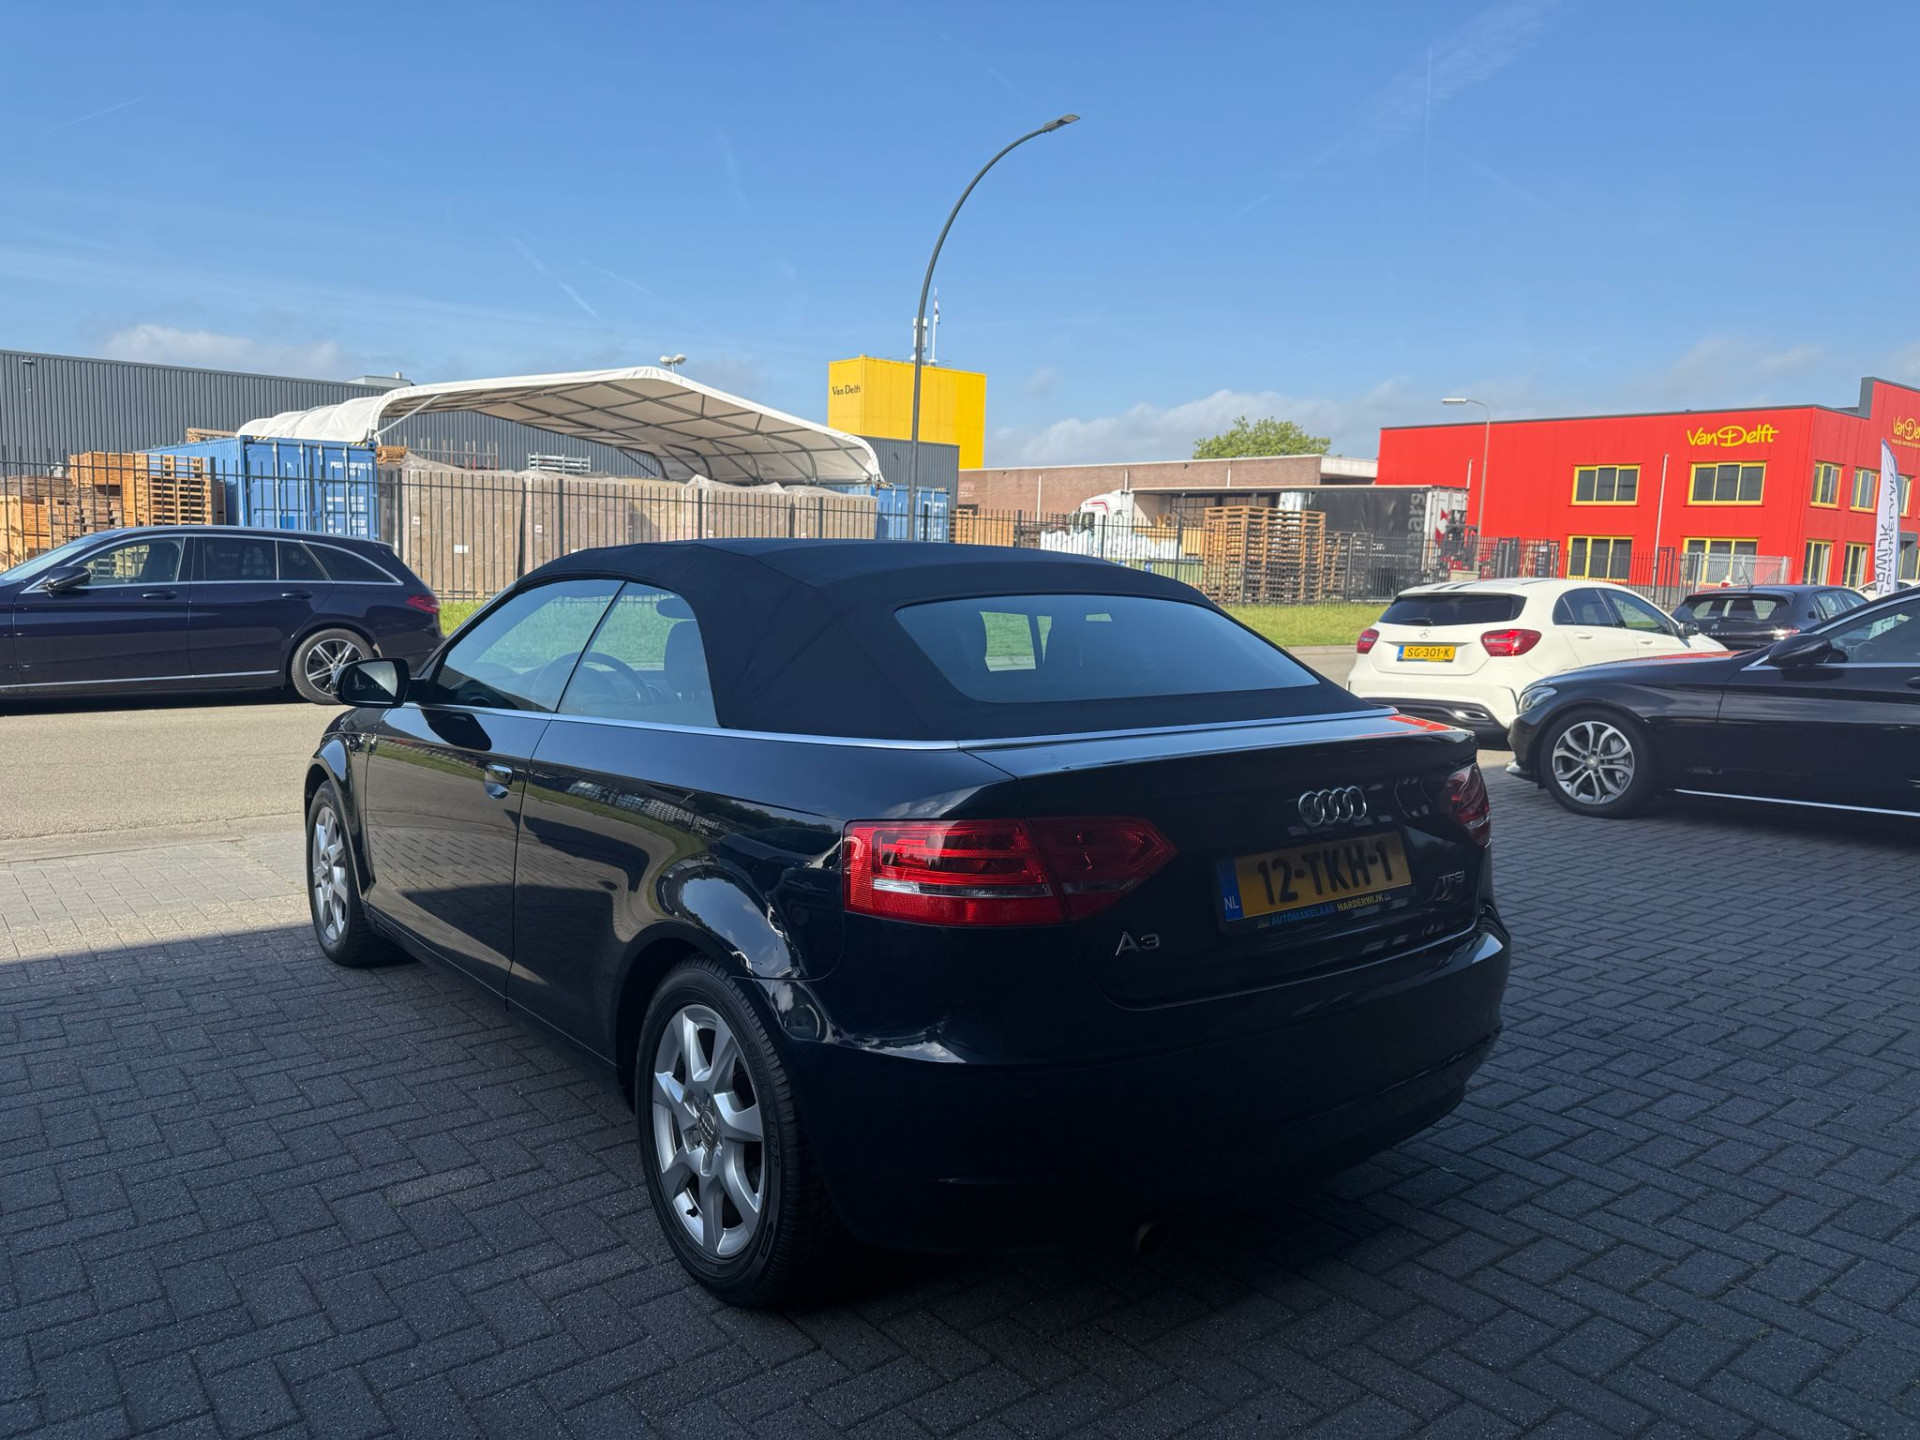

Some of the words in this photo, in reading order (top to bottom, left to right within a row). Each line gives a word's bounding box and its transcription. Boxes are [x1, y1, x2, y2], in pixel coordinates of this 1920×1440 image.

[832, 386, 844, 395] Van
[1686, 427, 1718, 446] Van
[1716, 424, 1779, 447] Delft
[1893, 415, 1905, 438] Van
[1407, 647, 1451, 658] SG-301-K
[1257, 841, 1393, 906] 12-TKH-1
[1223, 897, 1240, 911] NL
[1336, 893, 1385, 912] HARDERWIJK
[1115, 931, 1160, 956] A3
